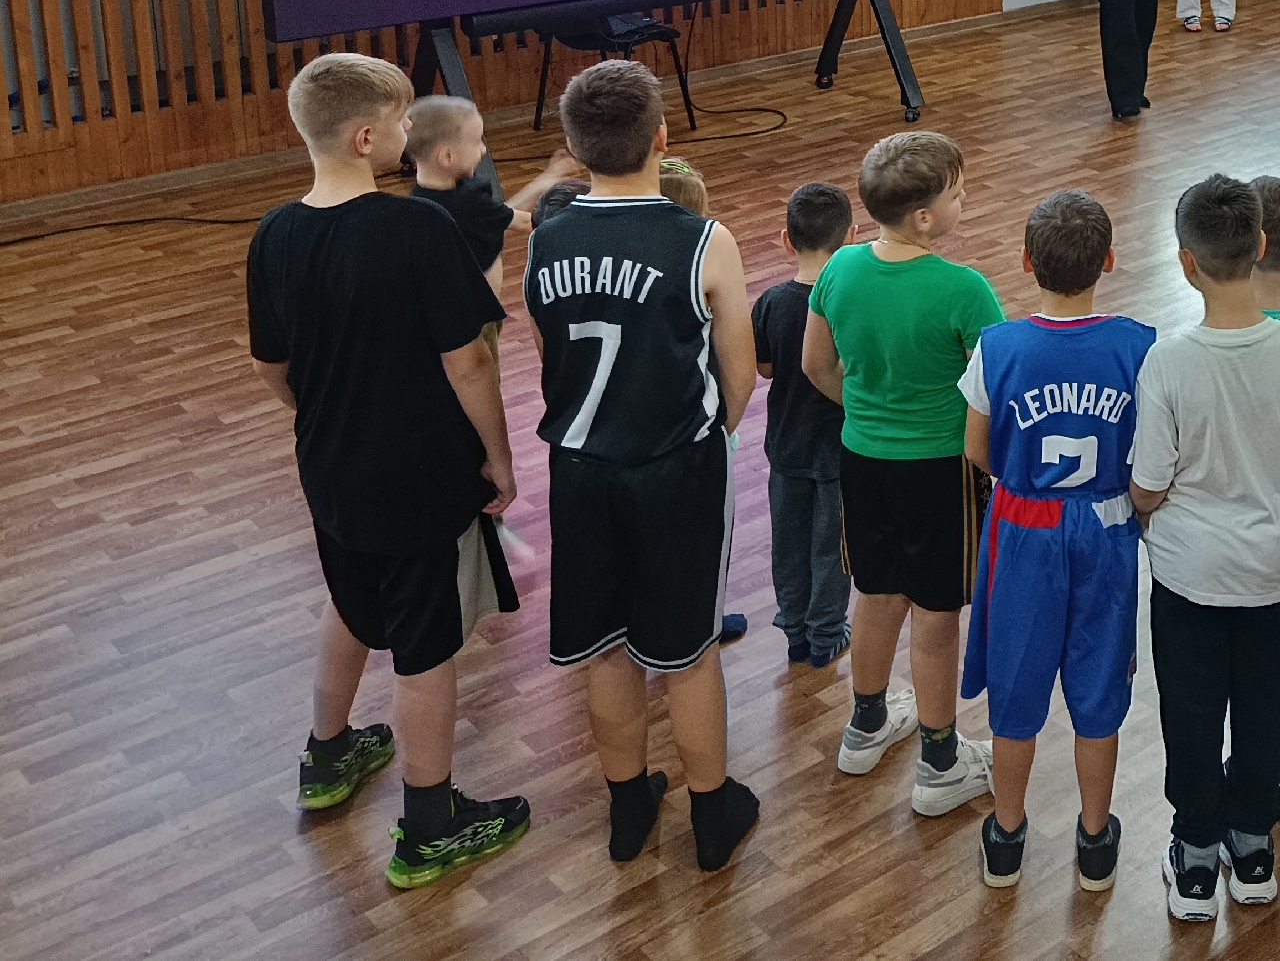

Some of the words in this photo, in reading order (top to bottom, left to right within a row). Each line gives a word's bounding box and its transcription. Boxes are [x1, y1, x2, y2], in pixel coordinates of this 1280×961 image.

[538, 256, 664, 305] DURANT
[560, 320, 622, 449] 7
[1009, 382, 1132, 430] LEONARD
